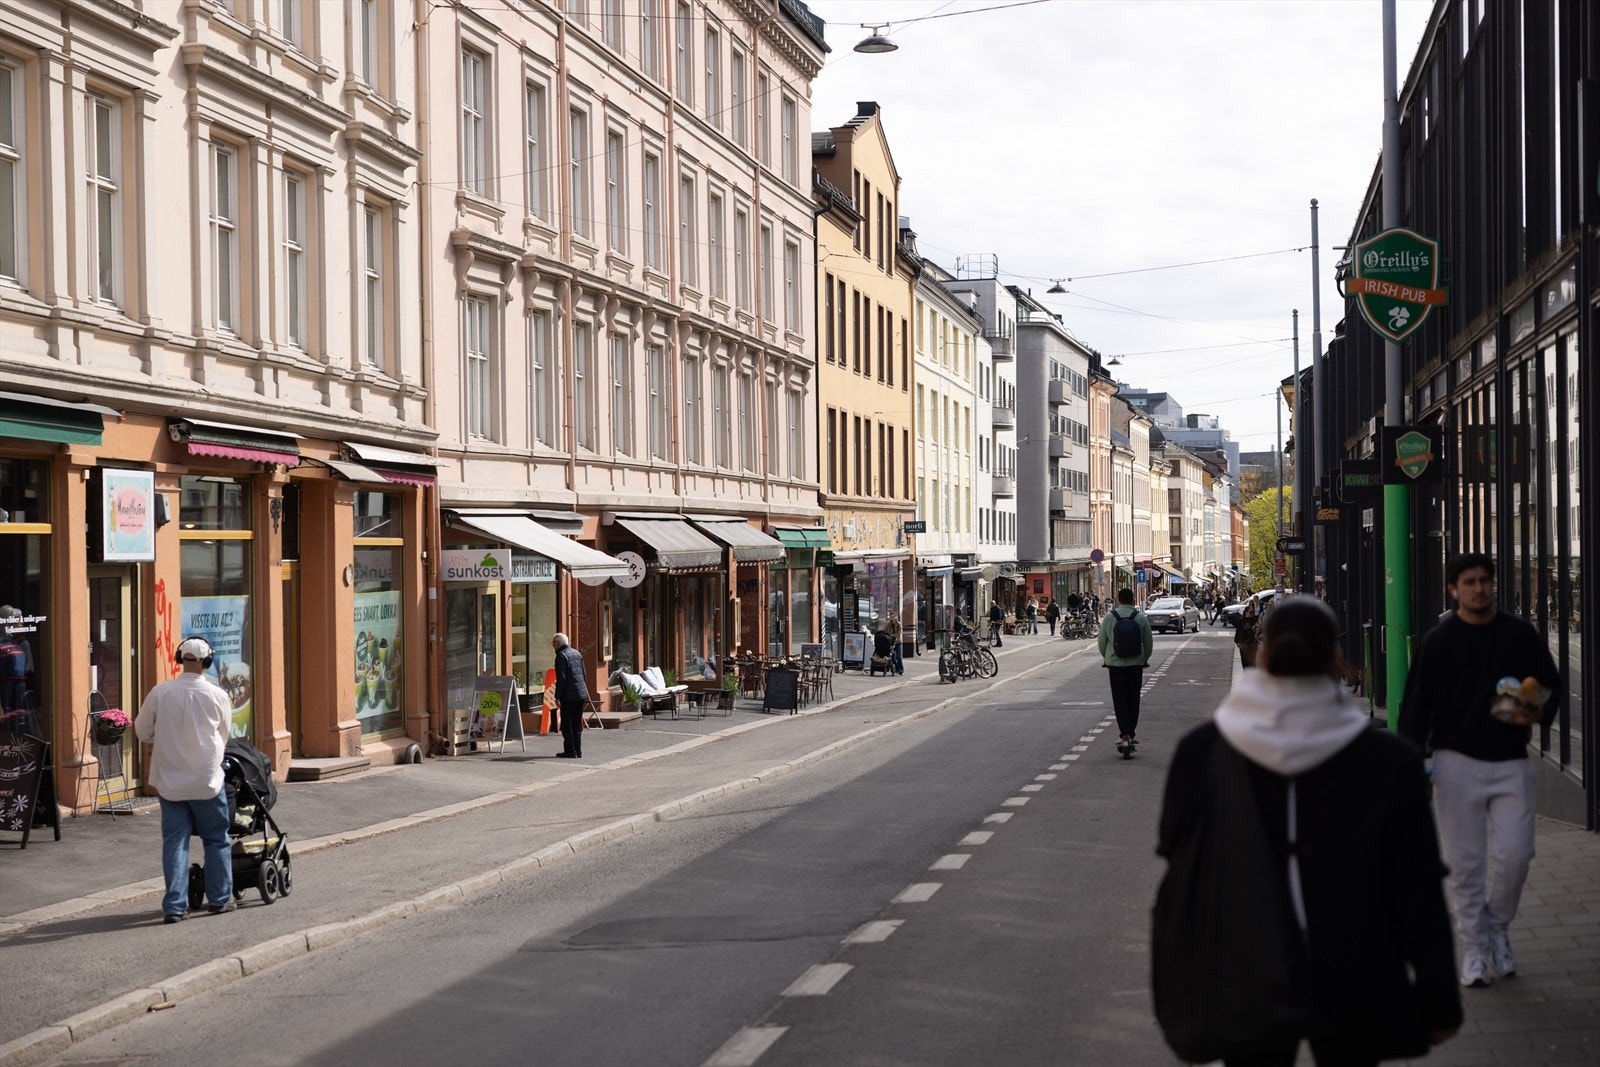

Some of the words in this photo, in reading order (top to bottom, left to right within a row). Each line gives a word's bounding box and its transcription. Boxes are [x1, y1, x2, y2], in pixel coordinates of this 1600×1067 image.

[1364, 280, 1399, 297] IRISH
[1401, 288, 1426, 302] PUB
[447, 564, 504, 578] sunkost
[190, 613, 210, 629] VISSTE
[211, 612, 220, 628] DU
[481, 700, 501, 709] -20%
